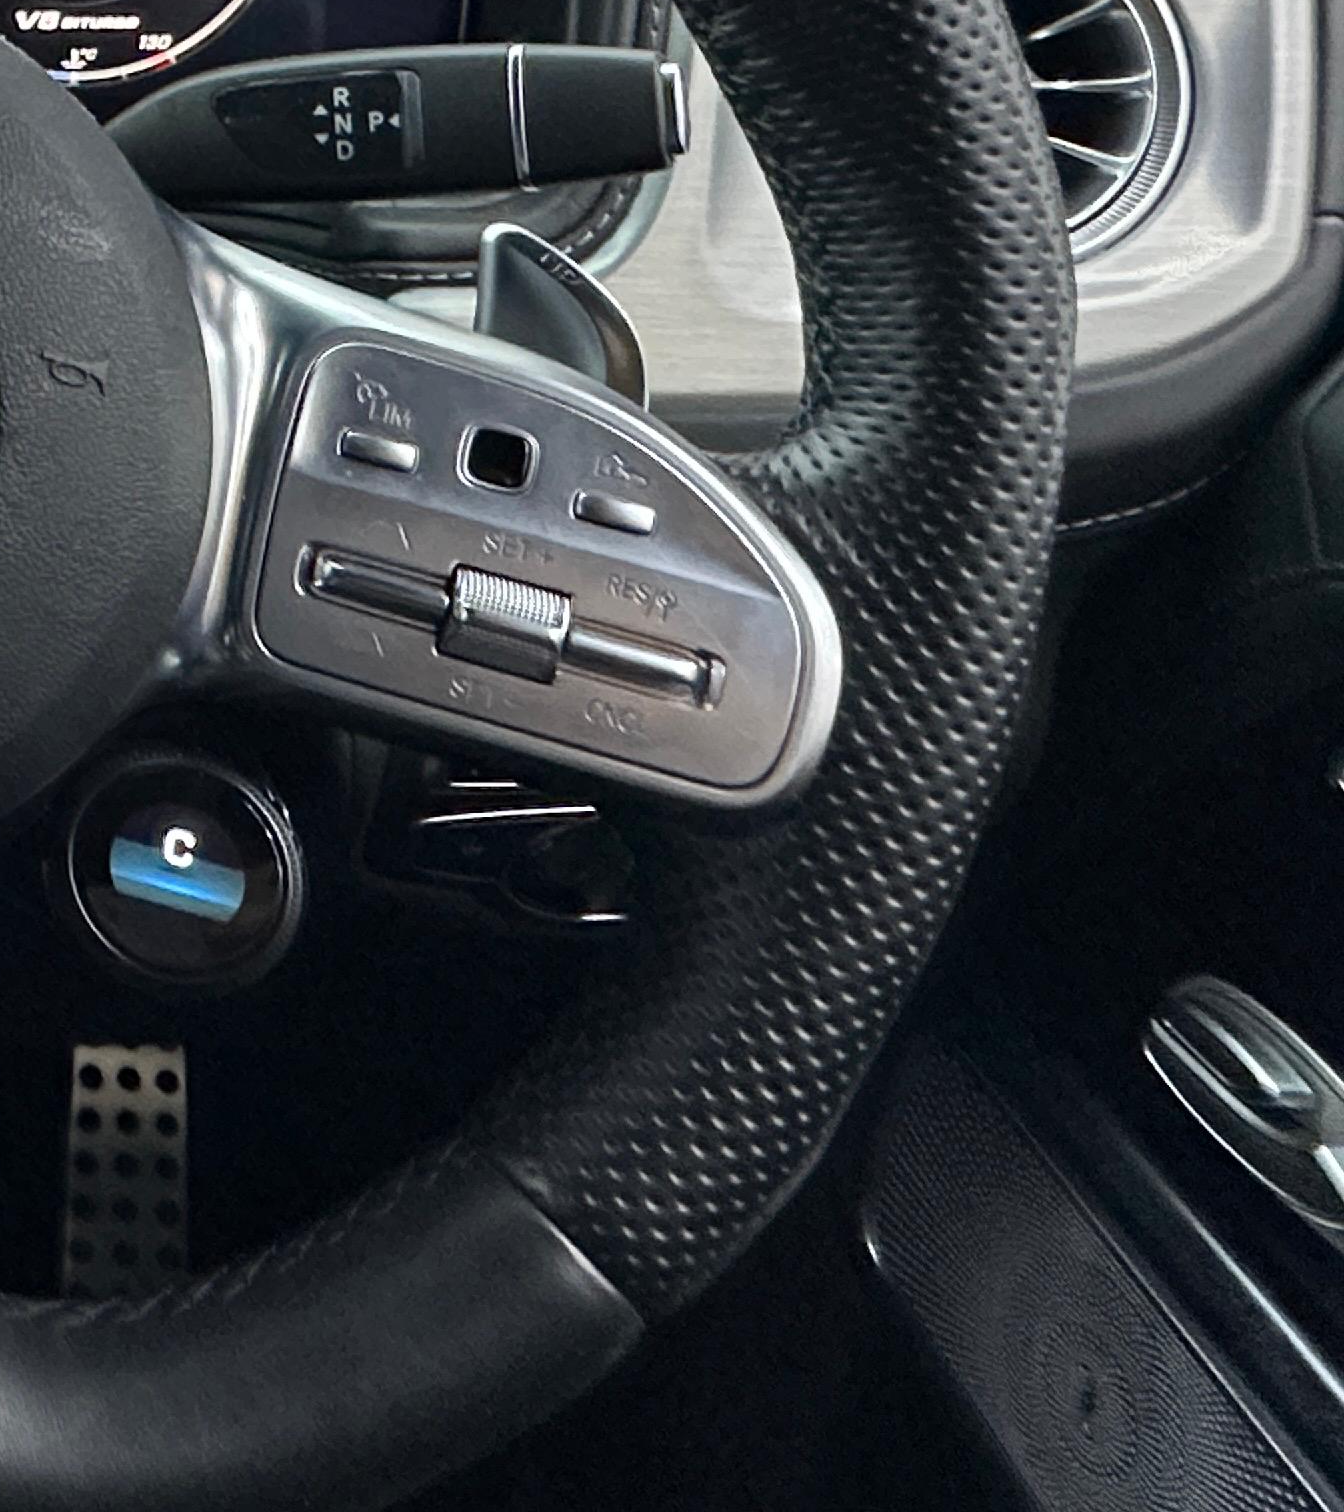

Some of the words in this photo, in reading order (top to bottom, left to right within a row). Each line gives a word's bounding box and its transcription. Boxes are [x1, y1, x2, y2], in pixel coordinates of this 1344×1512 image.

[14, 9, 61, 30] V8
[332, 86, 351, 108] R
[334, 112, 352, 135] N
[368, 110, 385, 133] P
[336, 139, 354, 162] D
[161, 827, 197, 869] C
